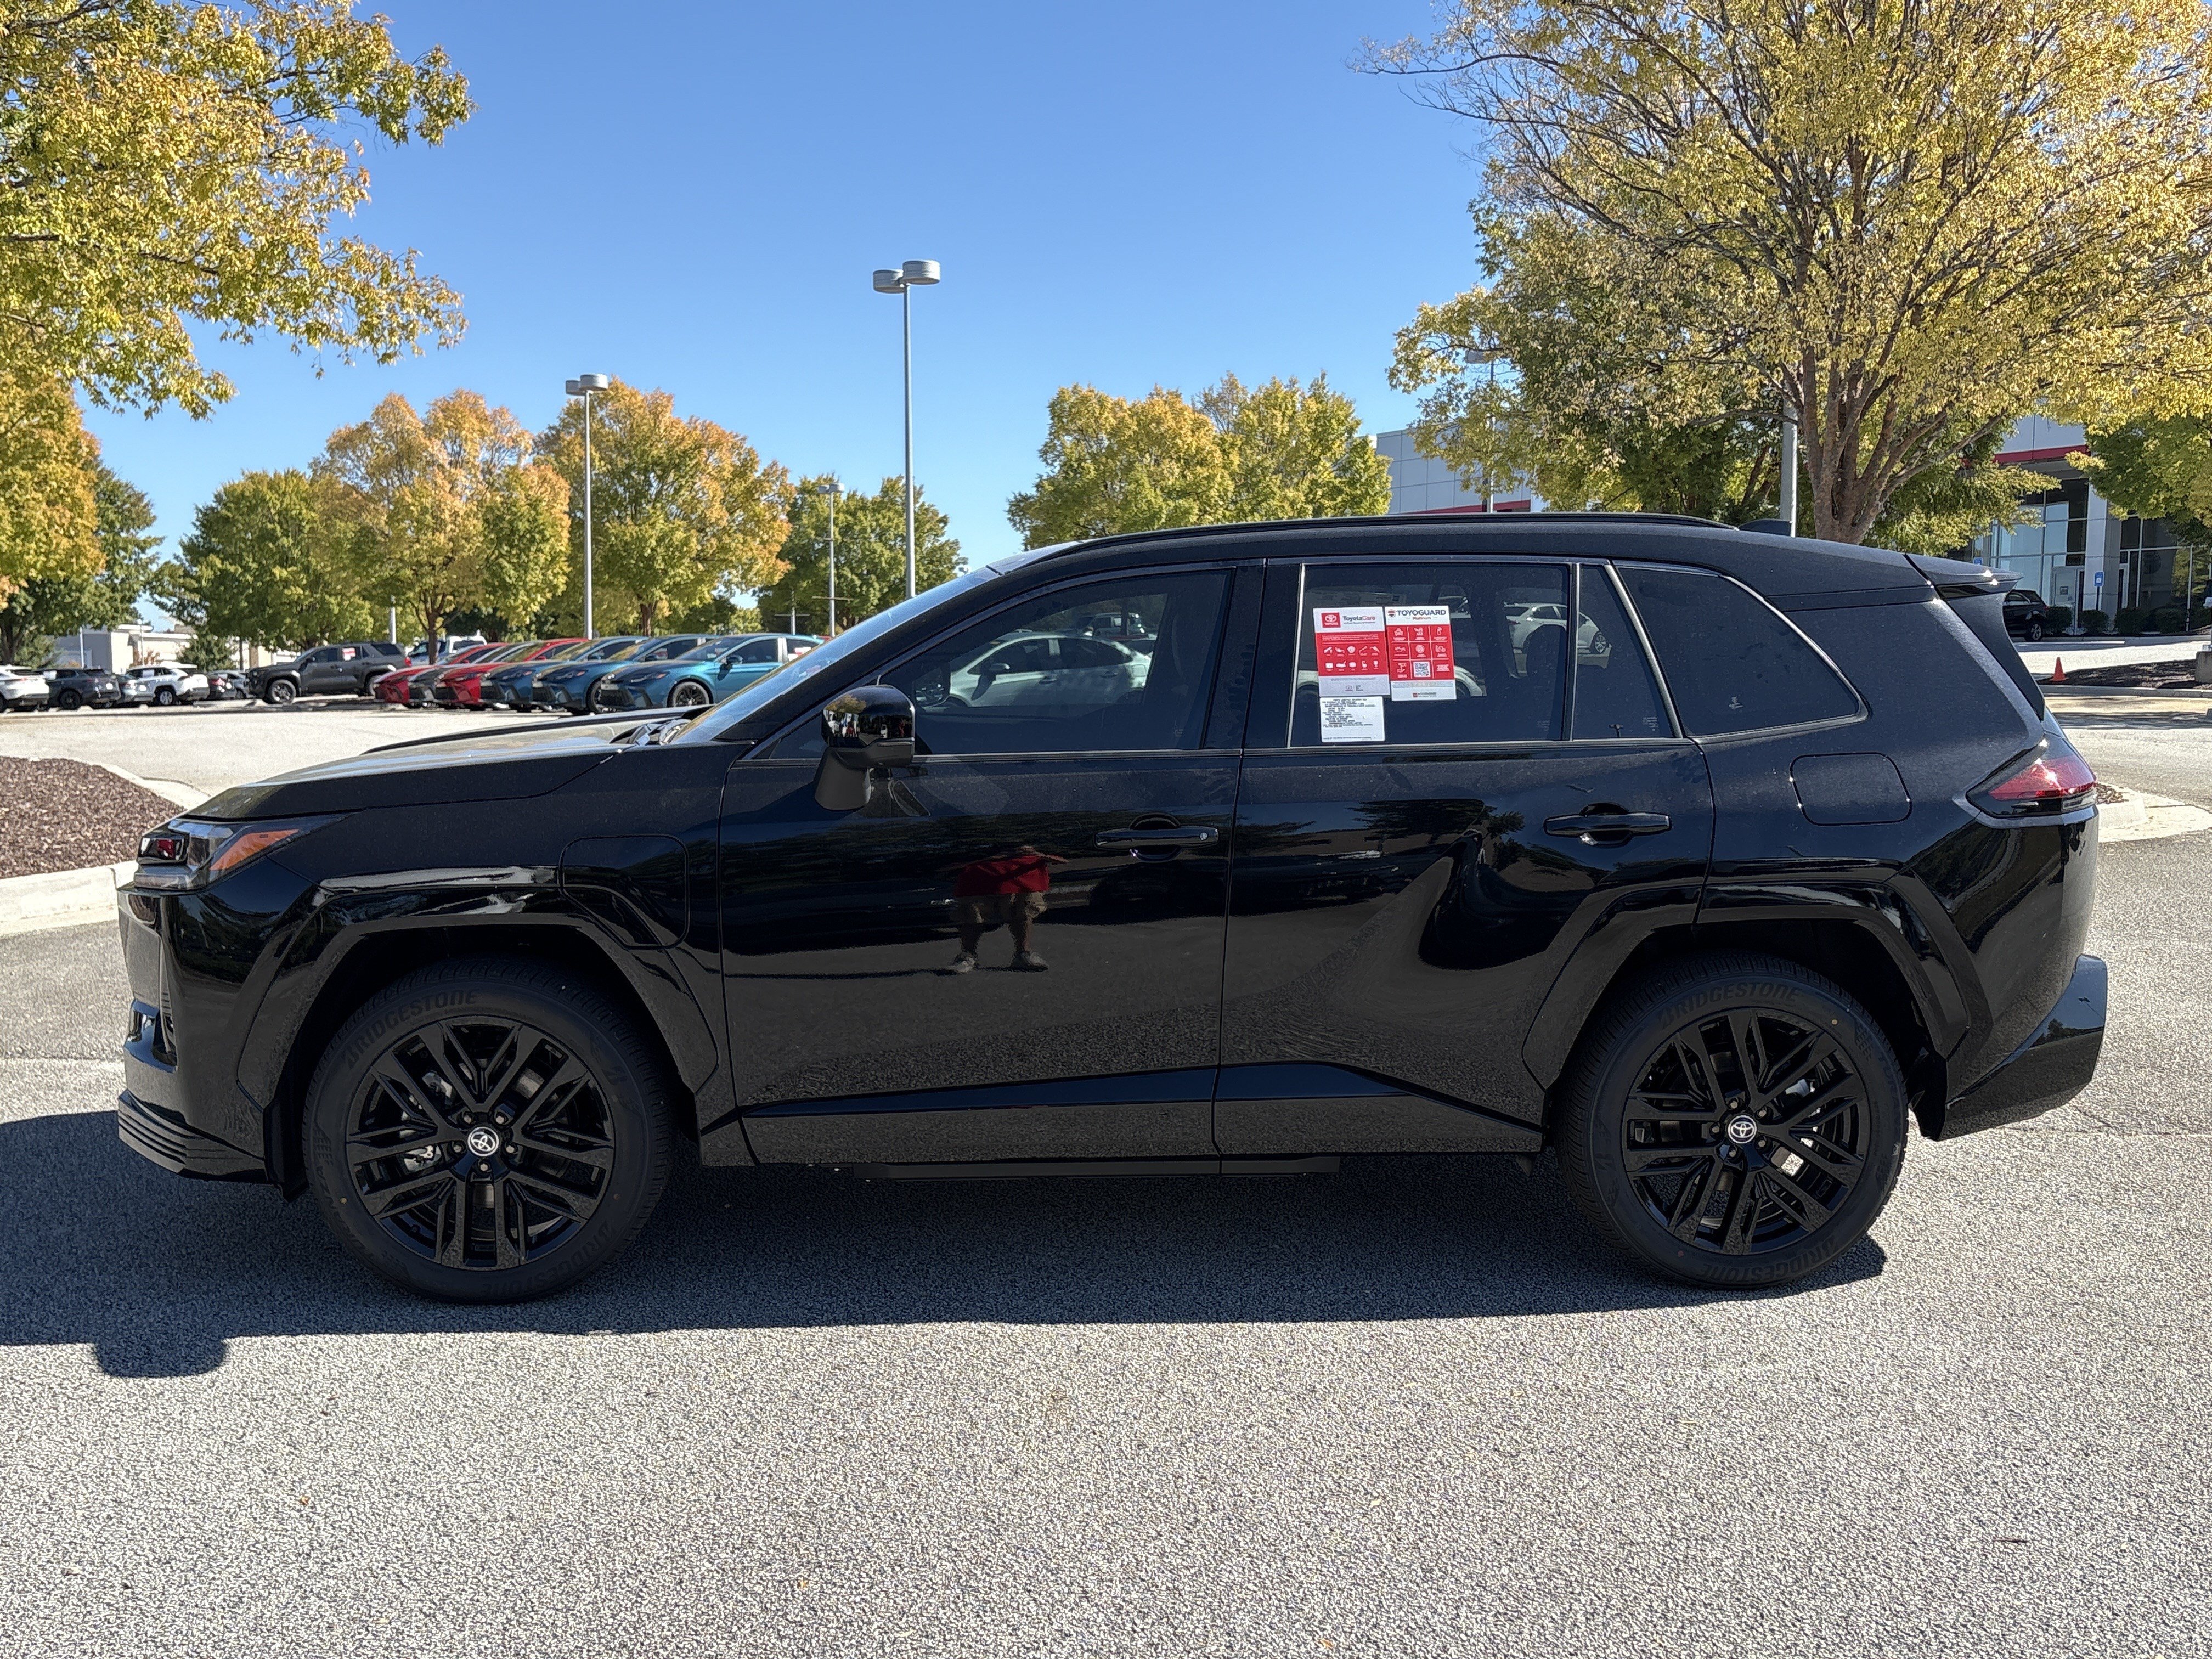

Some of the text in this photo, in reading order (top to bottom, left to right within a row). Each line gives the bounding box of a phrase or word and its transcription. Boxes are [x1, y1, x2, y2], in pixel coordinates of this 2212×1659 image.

[345, 988, 478, 1070] BRIDGESTONE
[1658, 981, 1804, 1030] BRIDGESTONE
[1695, 1234, 1838, 1283] BRIDGESTONE
